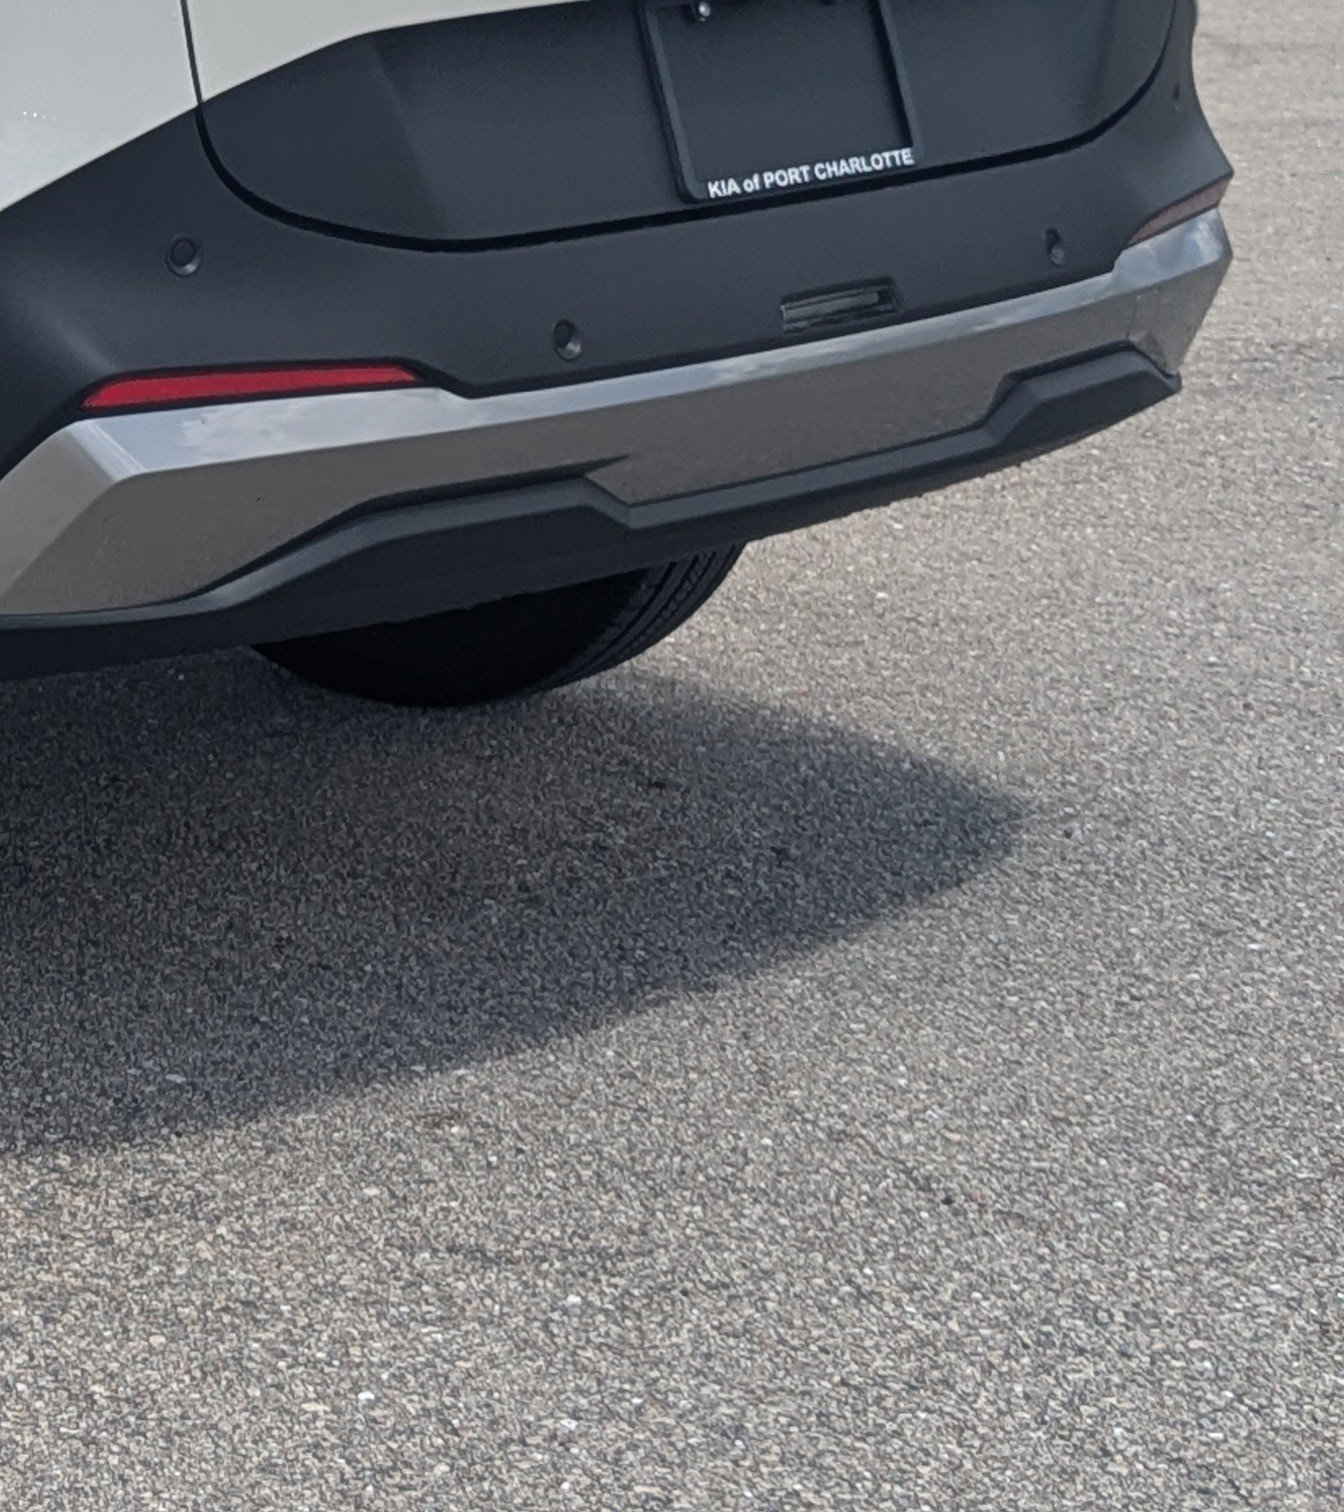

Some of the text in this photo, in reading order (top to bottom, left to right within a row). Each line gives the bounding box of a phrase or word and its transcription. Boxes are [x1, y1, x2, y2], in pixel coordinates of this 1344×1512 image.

[707, 146, 915, 199] KIA of PORT CHARLOTTE
